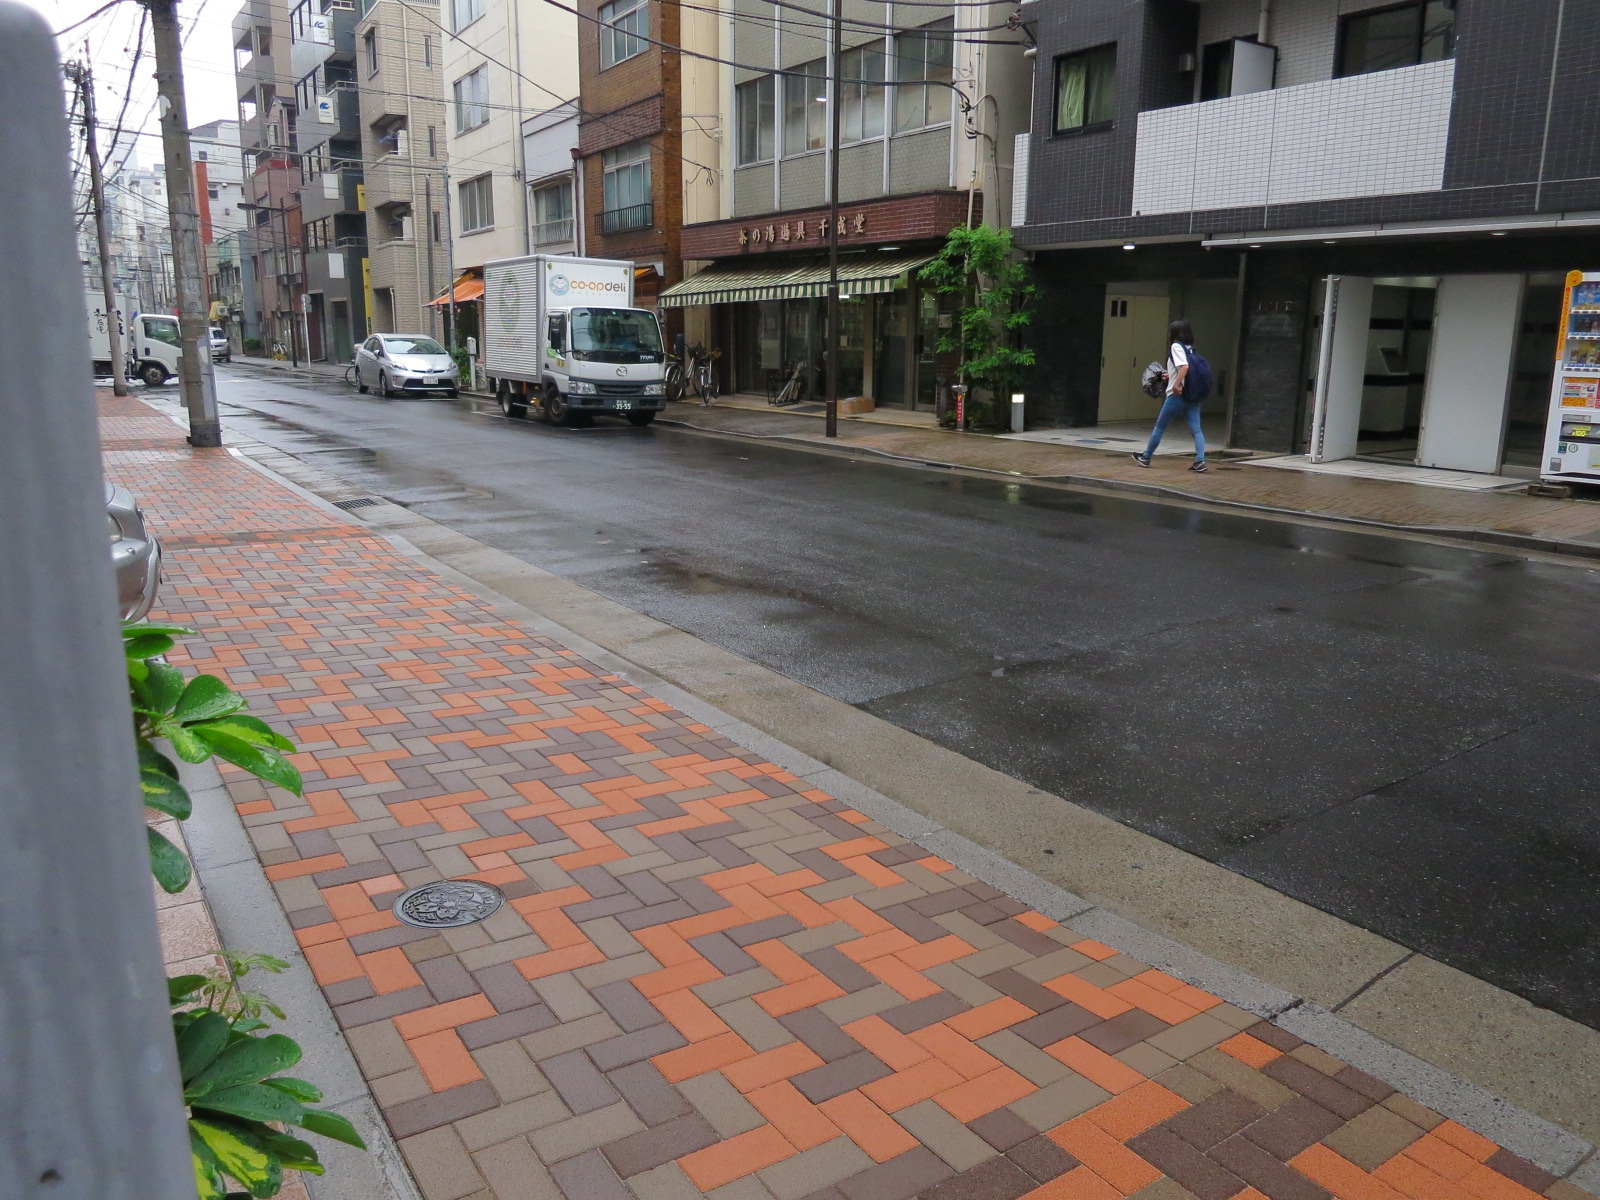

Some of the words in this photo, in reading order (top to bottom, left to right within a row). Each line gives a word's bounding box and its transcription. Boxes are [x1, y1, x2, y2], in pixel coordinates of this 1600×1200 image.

[739, 220, 806, 245] 茶の湯道具
[570, 280, 627, 293] co-opdeli
